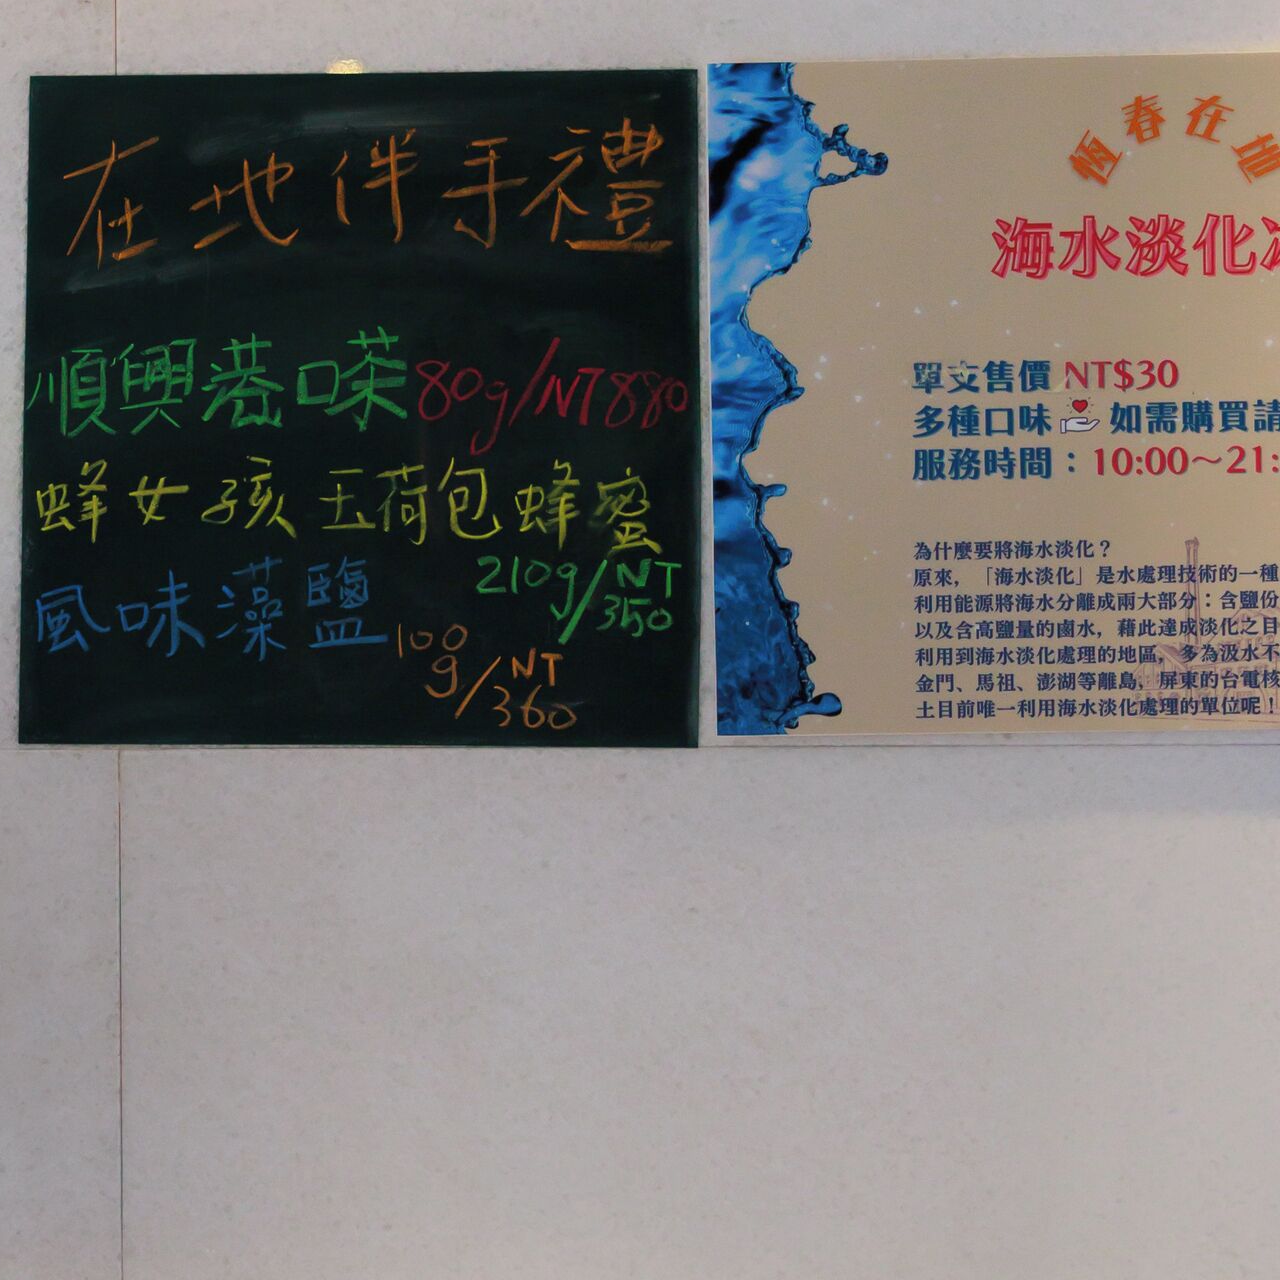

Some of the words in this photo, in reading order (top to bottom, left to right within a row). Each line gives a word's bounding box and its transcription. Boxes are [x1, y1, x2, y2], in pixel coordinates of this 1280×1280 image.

[64, 118, 673, 270] 在地伴手禮
[26, 326, 409, 437] 順興港口茶
[416, 337, 689, 457] 80g/NT880
[912, 403, 1053, 439] 多種口味
[1064, 359, 1180, 392] NT$30
[35, 556, 389, 661] 風味藻鹽
